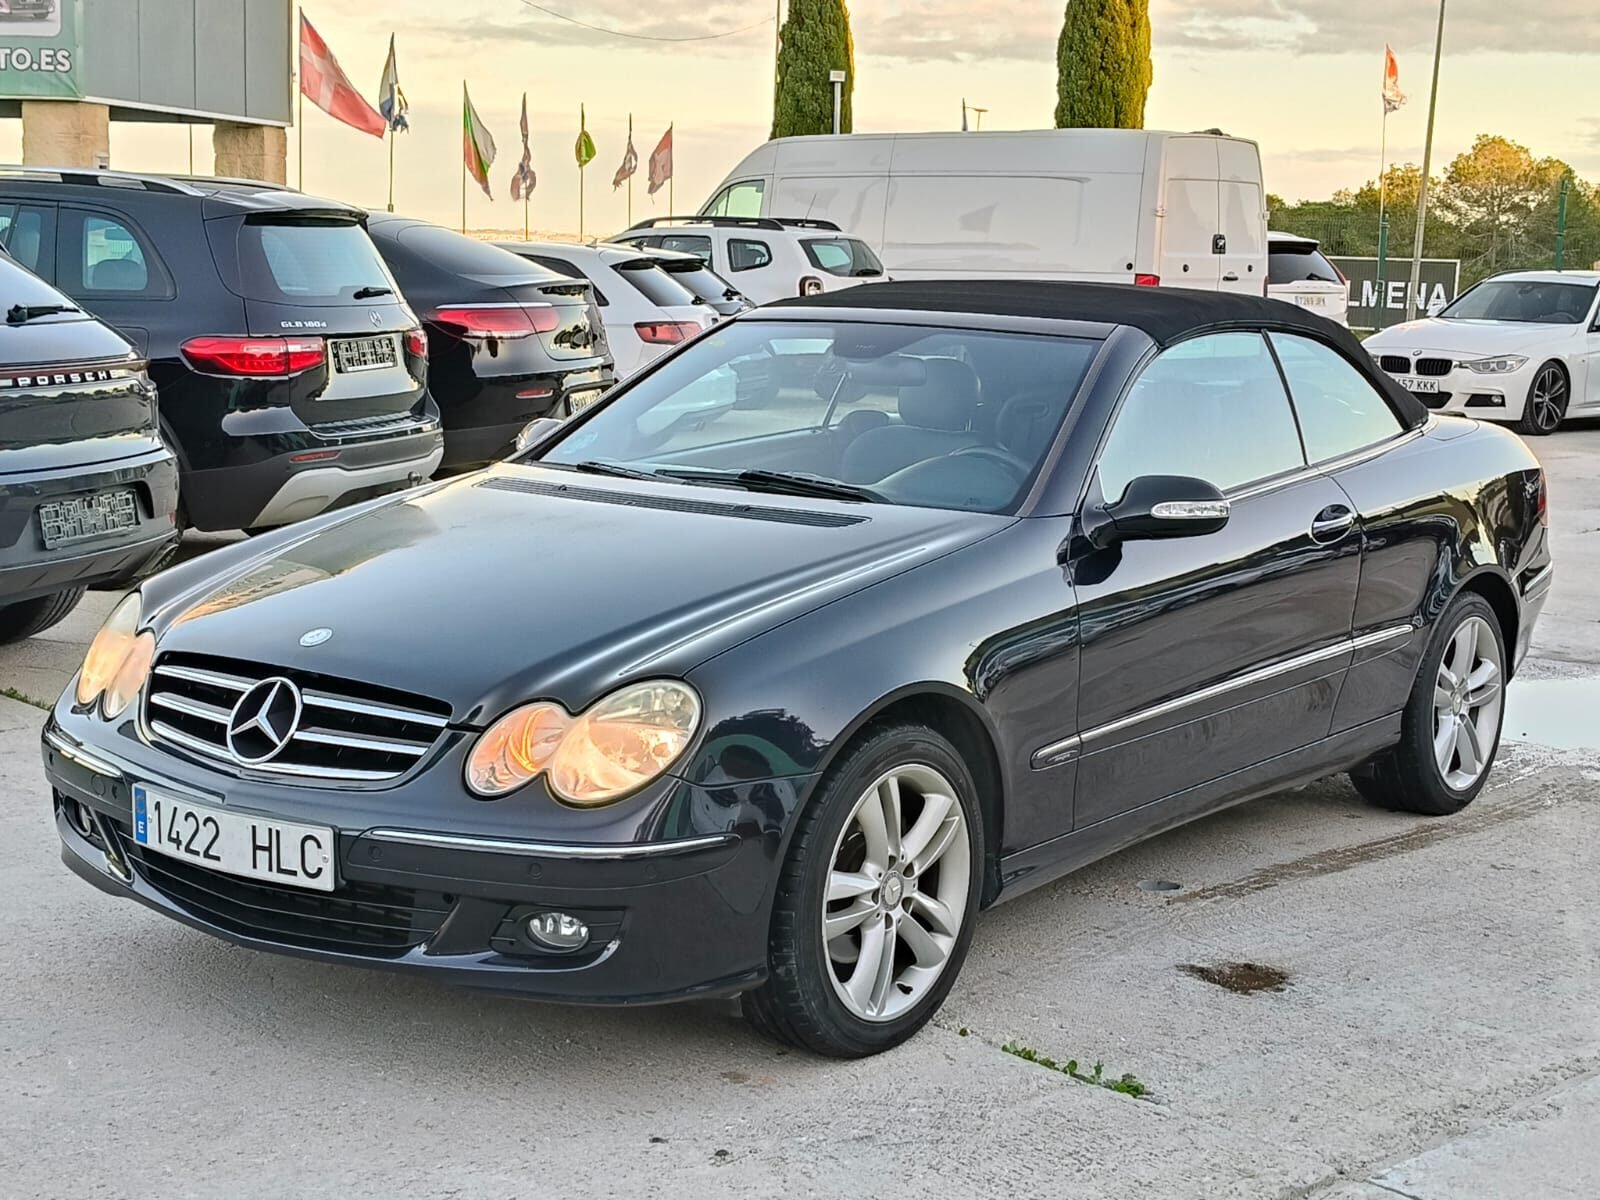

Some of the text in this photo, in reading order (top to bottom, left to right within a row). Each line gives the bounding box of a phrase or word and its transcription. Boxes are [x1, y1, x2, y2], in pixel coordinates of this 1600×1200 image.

[0, 47, 72, 73] TO.ES
[18, 369, 121, 387] PORSCHE
[1398, 379, 1436, 391] 57 KKK
[138, 820, 145, 834] E
[154, 800, 323, 880] 1422 HLC
